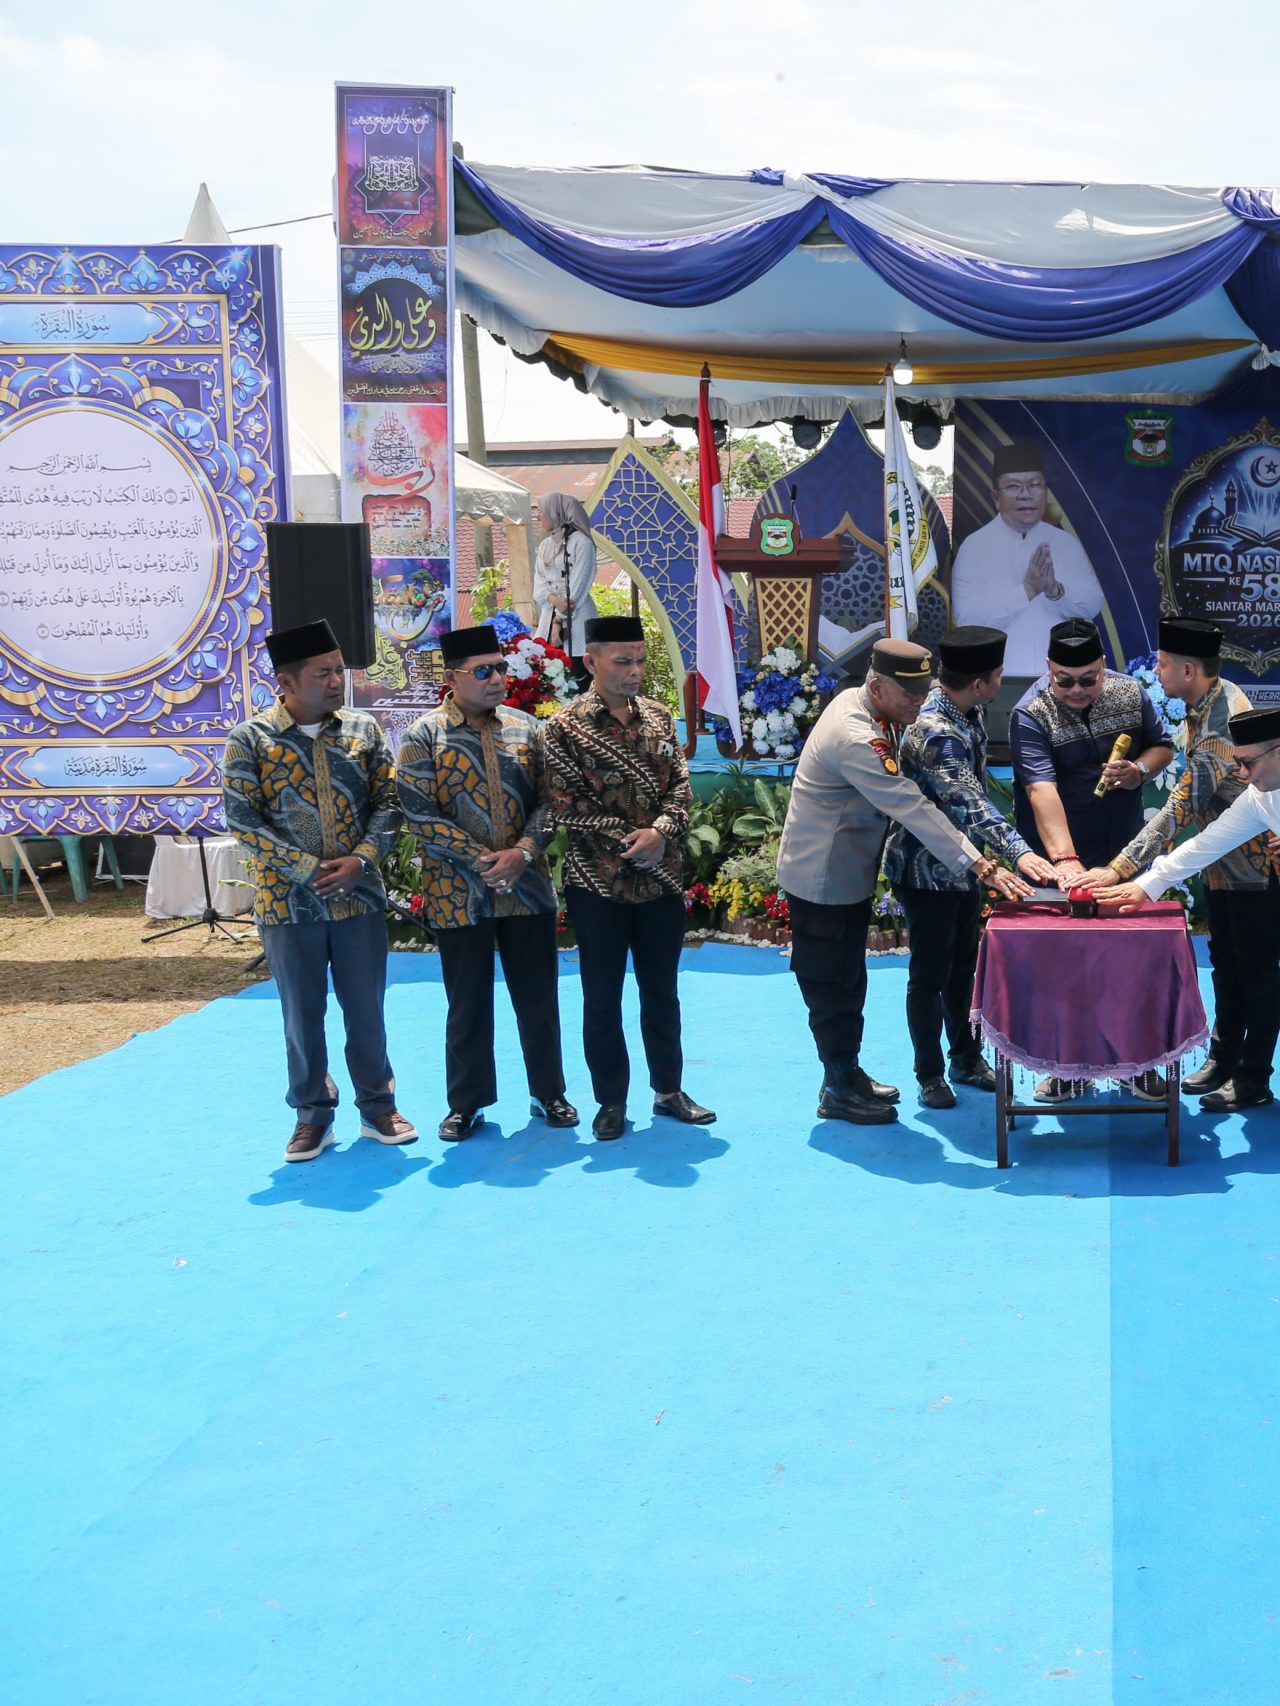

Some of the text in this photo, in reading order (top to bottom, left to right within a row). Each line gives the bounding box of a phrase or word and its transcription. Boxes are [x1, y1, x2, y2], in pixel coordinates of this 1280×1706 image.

[1183, 552, 1234, 574] MTQ
[1229, 576, 1241, 586] KE
[1205, 601, 1252, 612] SIANTAR
